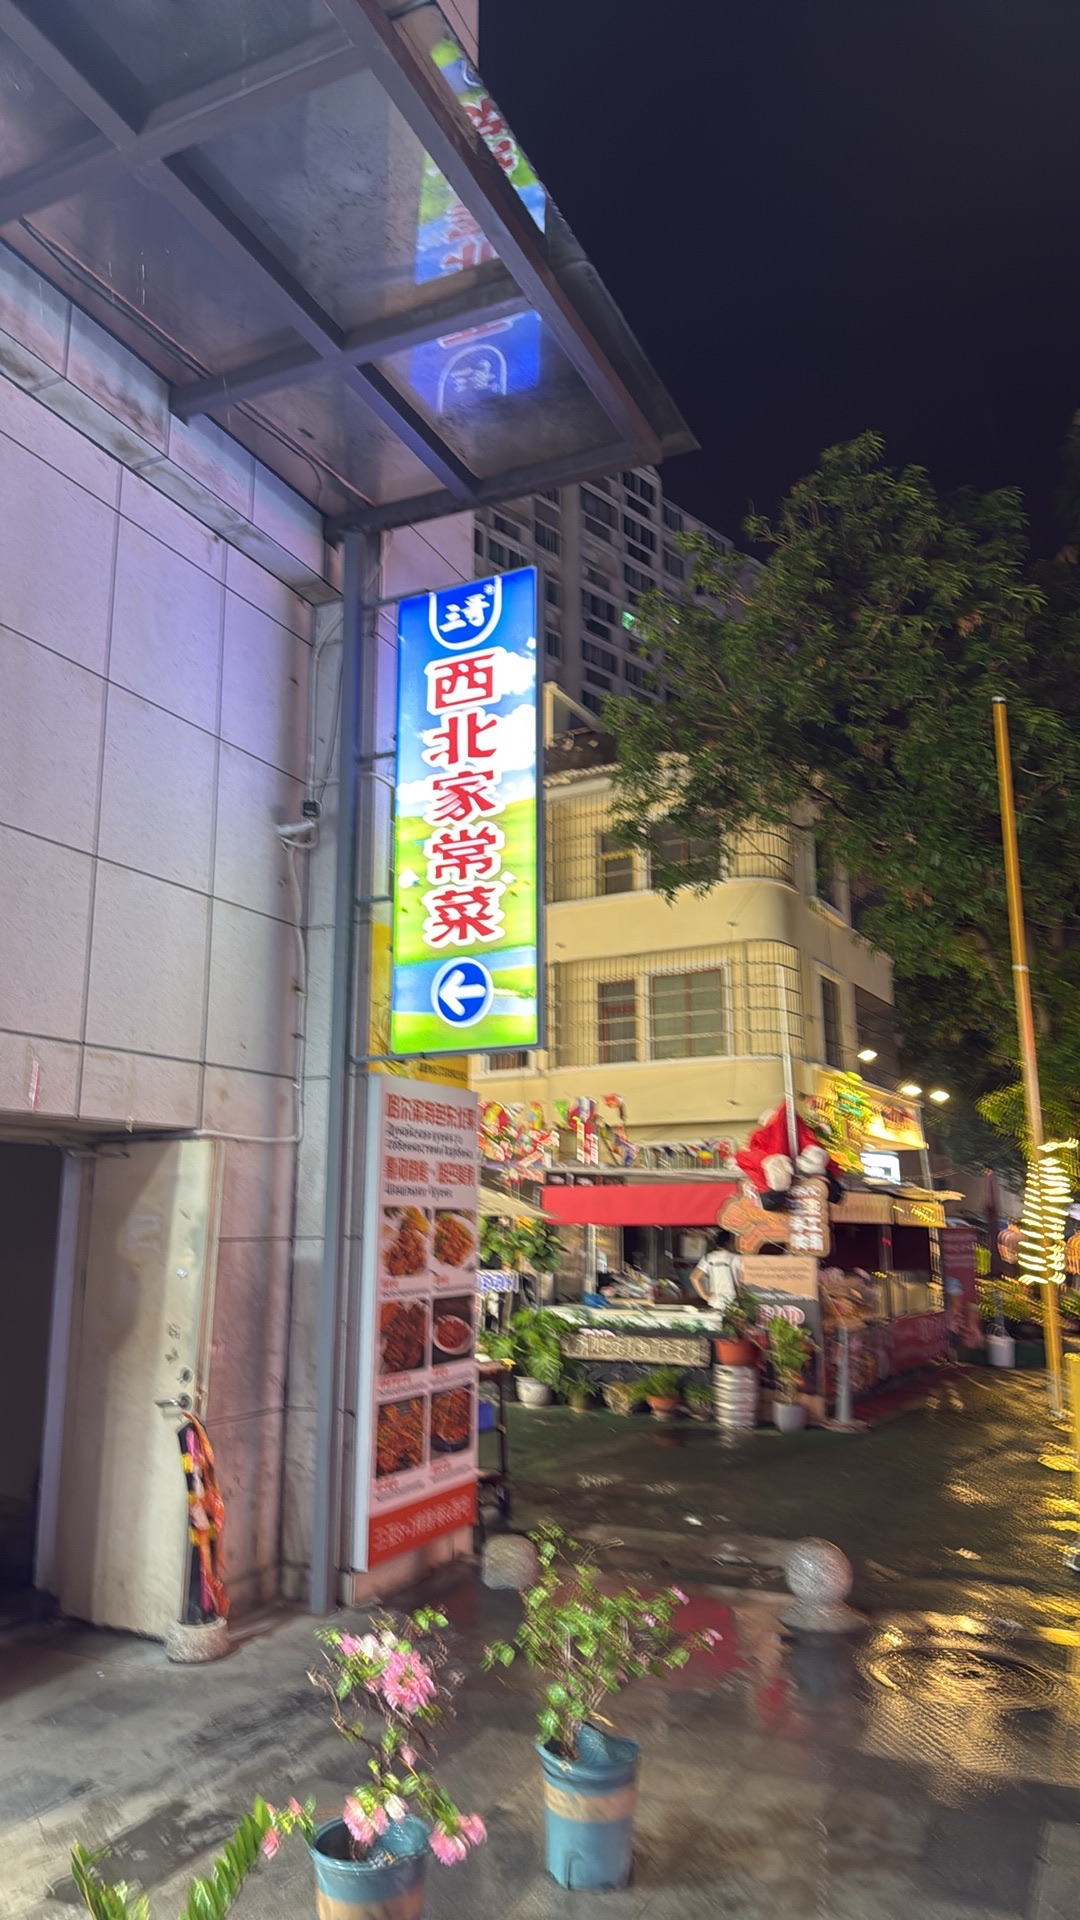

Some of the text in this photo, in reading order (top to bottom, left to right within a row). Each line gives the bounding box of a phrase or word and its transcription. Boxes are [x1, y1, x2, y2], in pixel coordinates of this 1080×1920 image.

[428, 651, 500, 943] 西北家常菜
